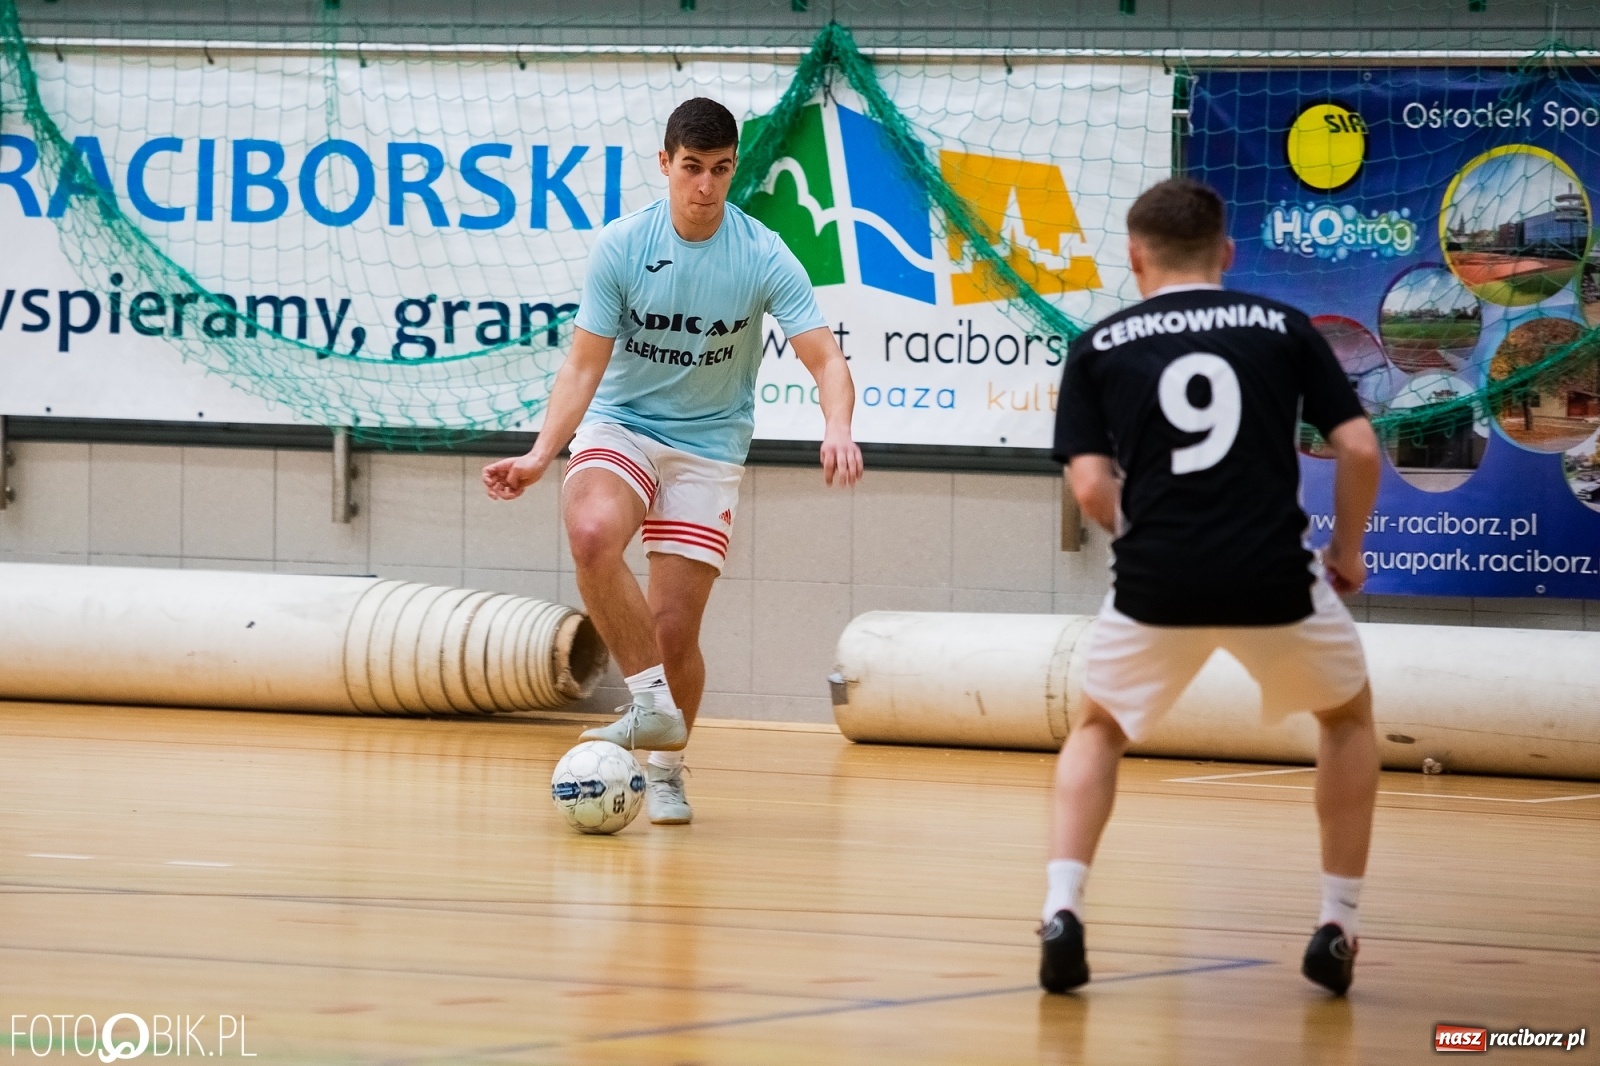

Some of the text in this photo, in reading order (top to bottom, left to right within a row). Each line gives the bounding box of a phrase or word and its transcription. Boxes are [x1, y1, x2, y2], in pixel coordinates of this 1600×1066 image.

[1323, 112, 1369, 134] SIR
[1402, 100, 1600, 133] Ośrodek Spo
[0, 134, 623, 231] RACIBORSKI
[1091, 303, 1288, 351] CERKOWNIAK
[863, 385, 956, 409] oaza
[1158, 352, 1242, 475] 9
